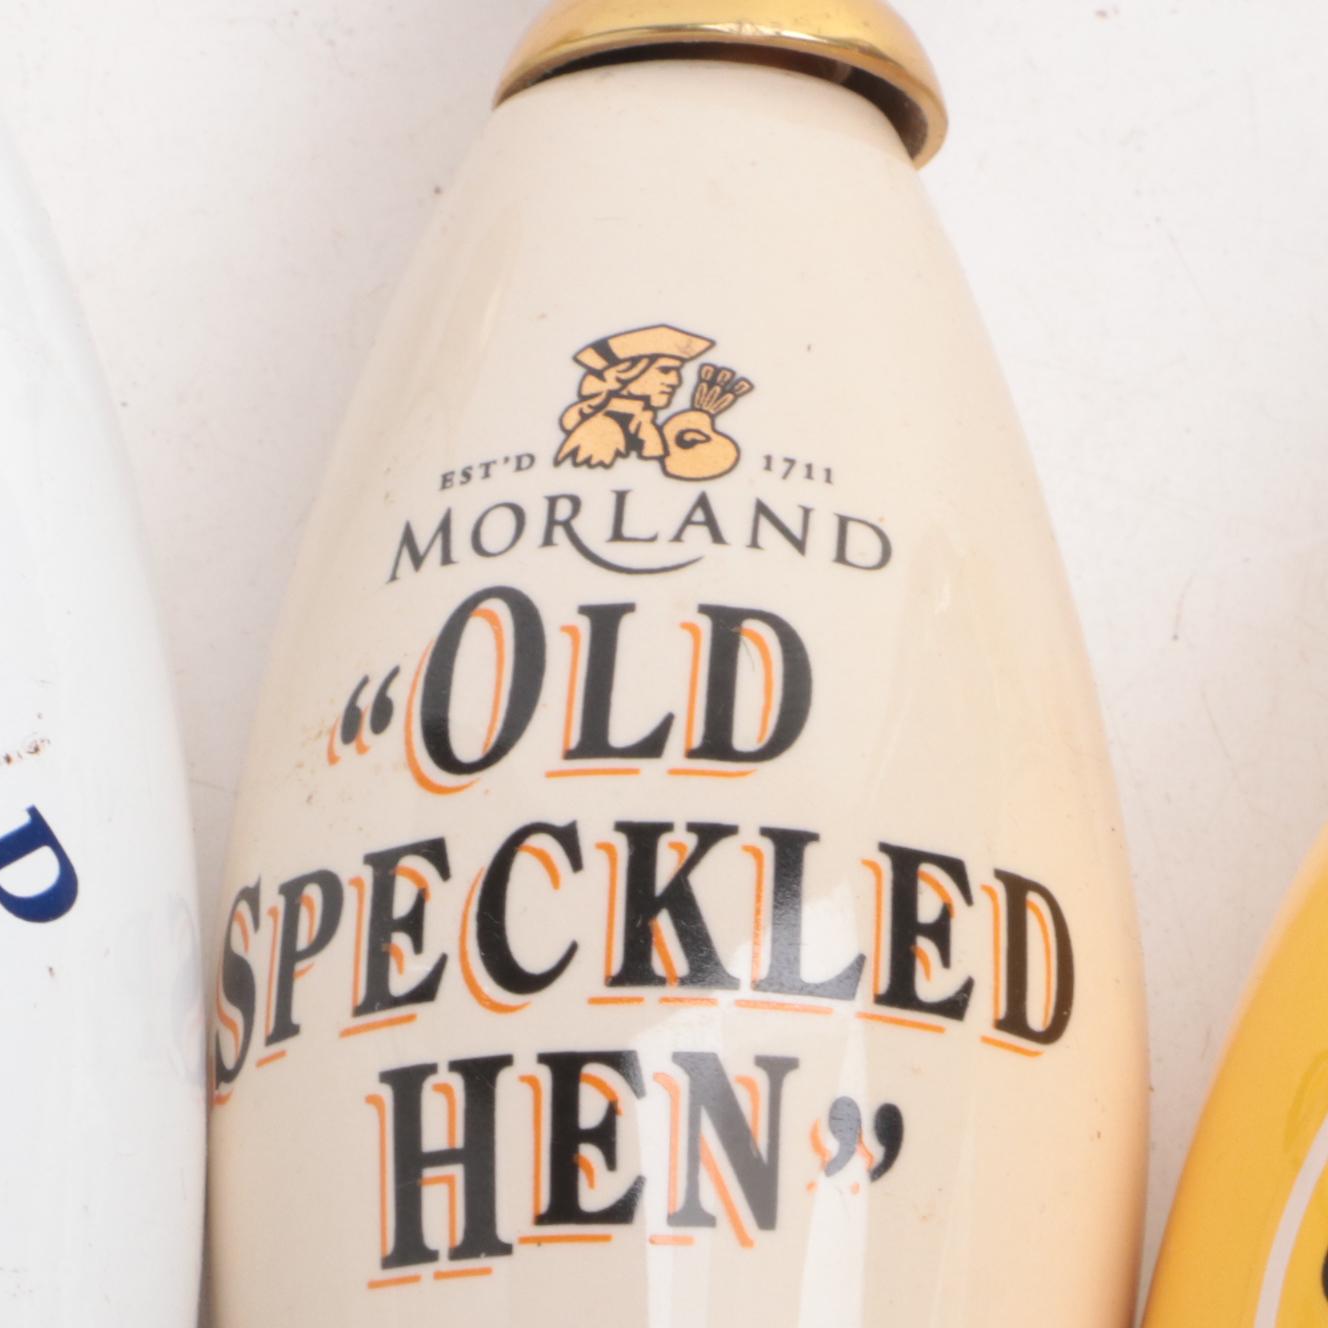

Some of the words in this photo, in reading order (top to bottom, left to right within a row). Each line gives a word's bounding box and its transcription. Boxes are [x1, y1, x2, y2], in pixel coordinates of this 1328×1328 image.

[761, 454, 834, 486] 1711
[387, 489, 893, 584] MORLAND
[212, 819, 1075, 1100] SPECKLED
